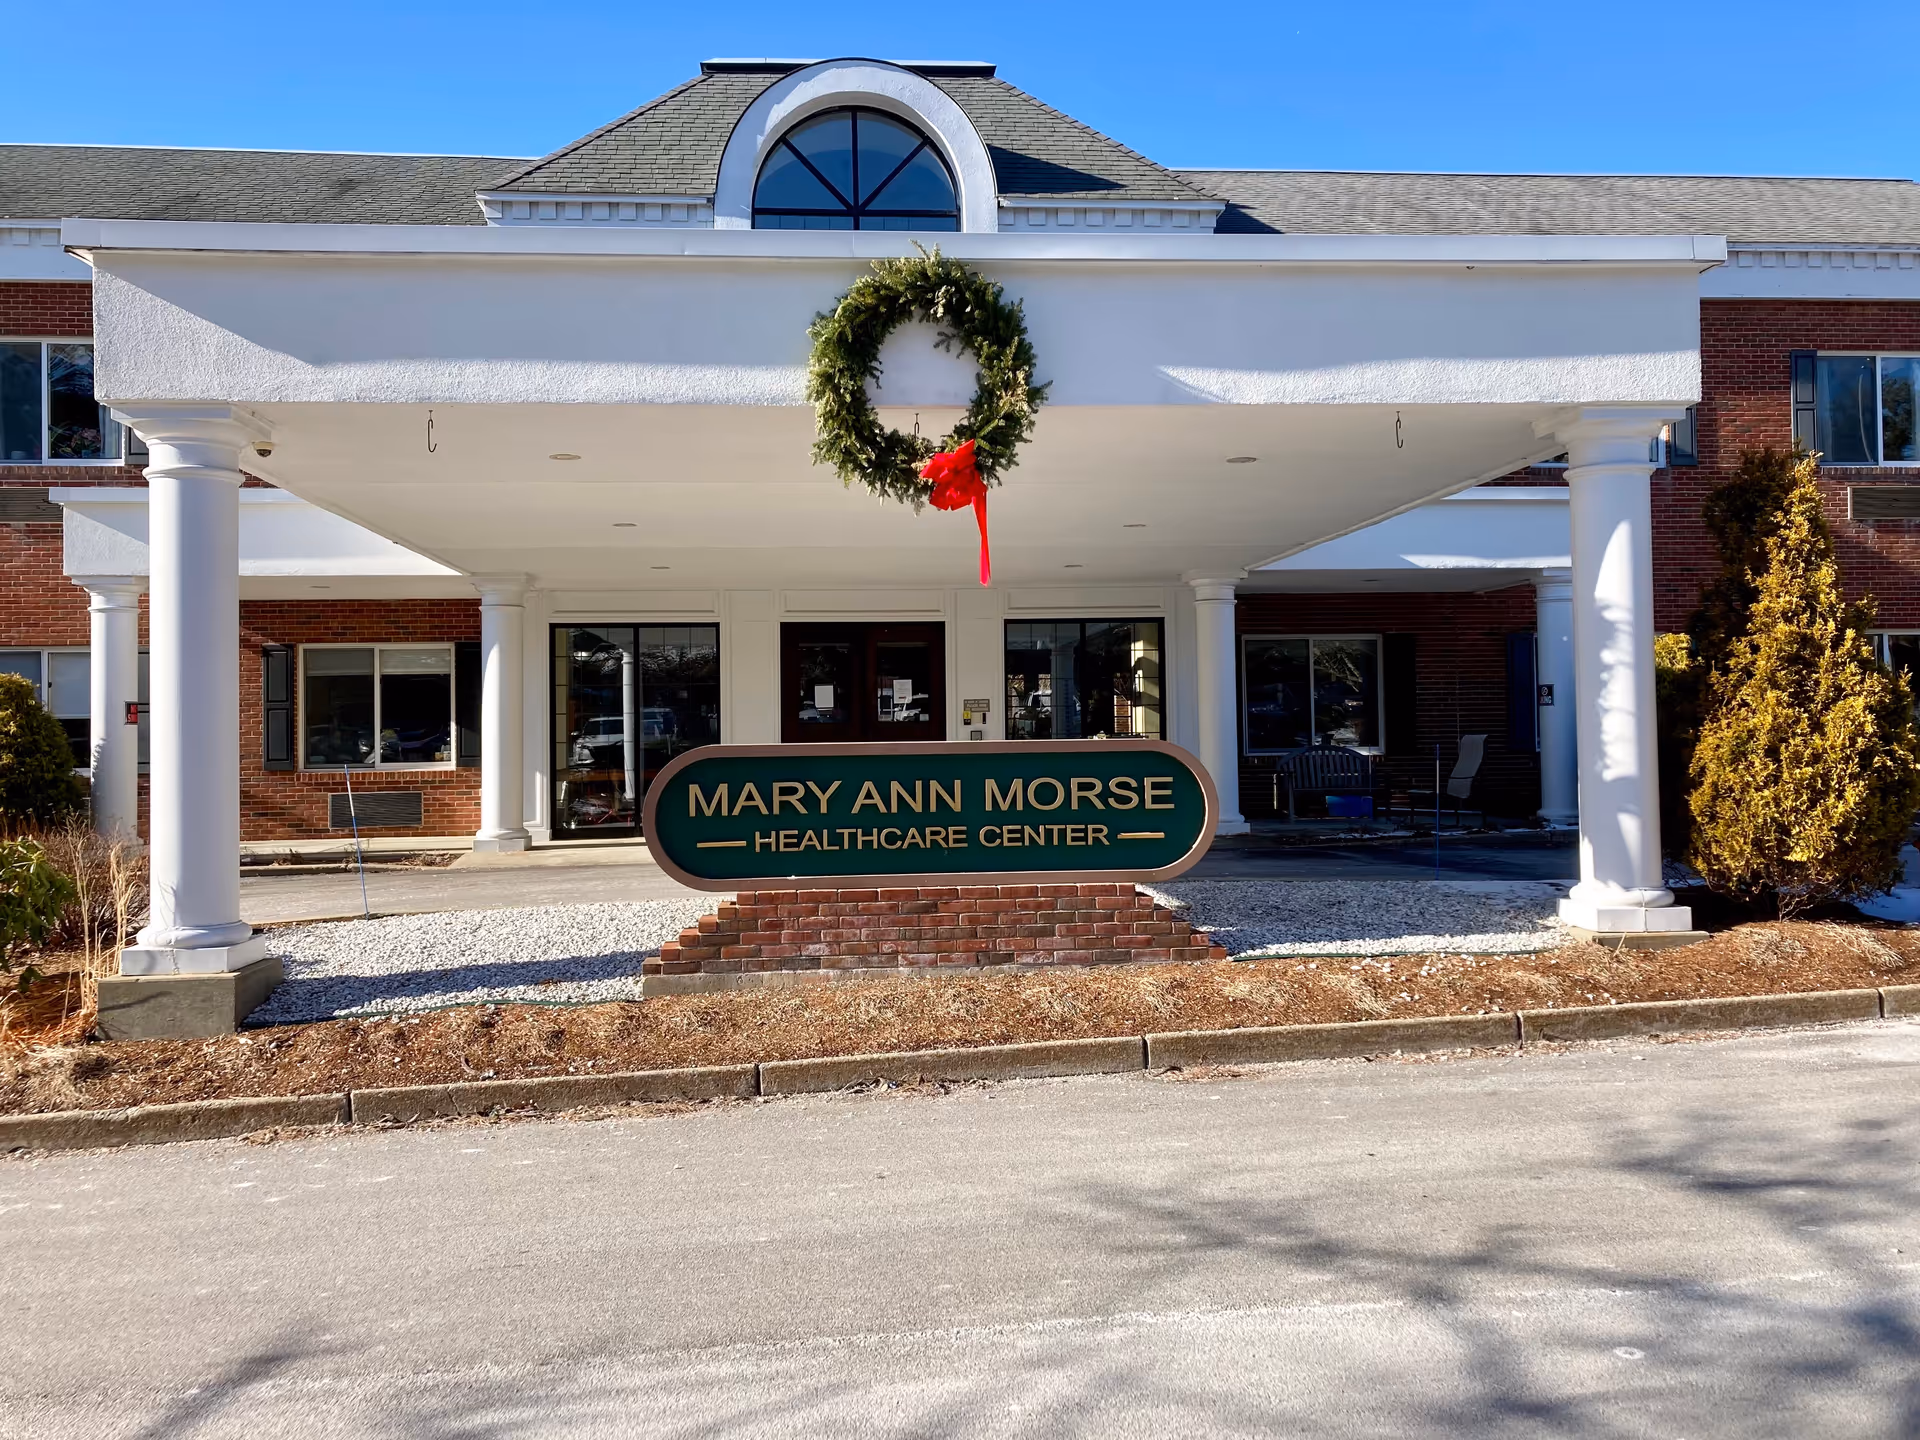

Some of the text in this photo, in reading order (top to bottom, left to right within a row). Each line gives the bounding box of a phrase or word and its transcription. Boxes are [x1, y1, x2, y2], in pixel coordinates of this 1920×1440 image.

[689, 777, 1175, 817] MARY ANN MORSE
[755, 824, 1110, 853] HEALTHCARE CENTER
